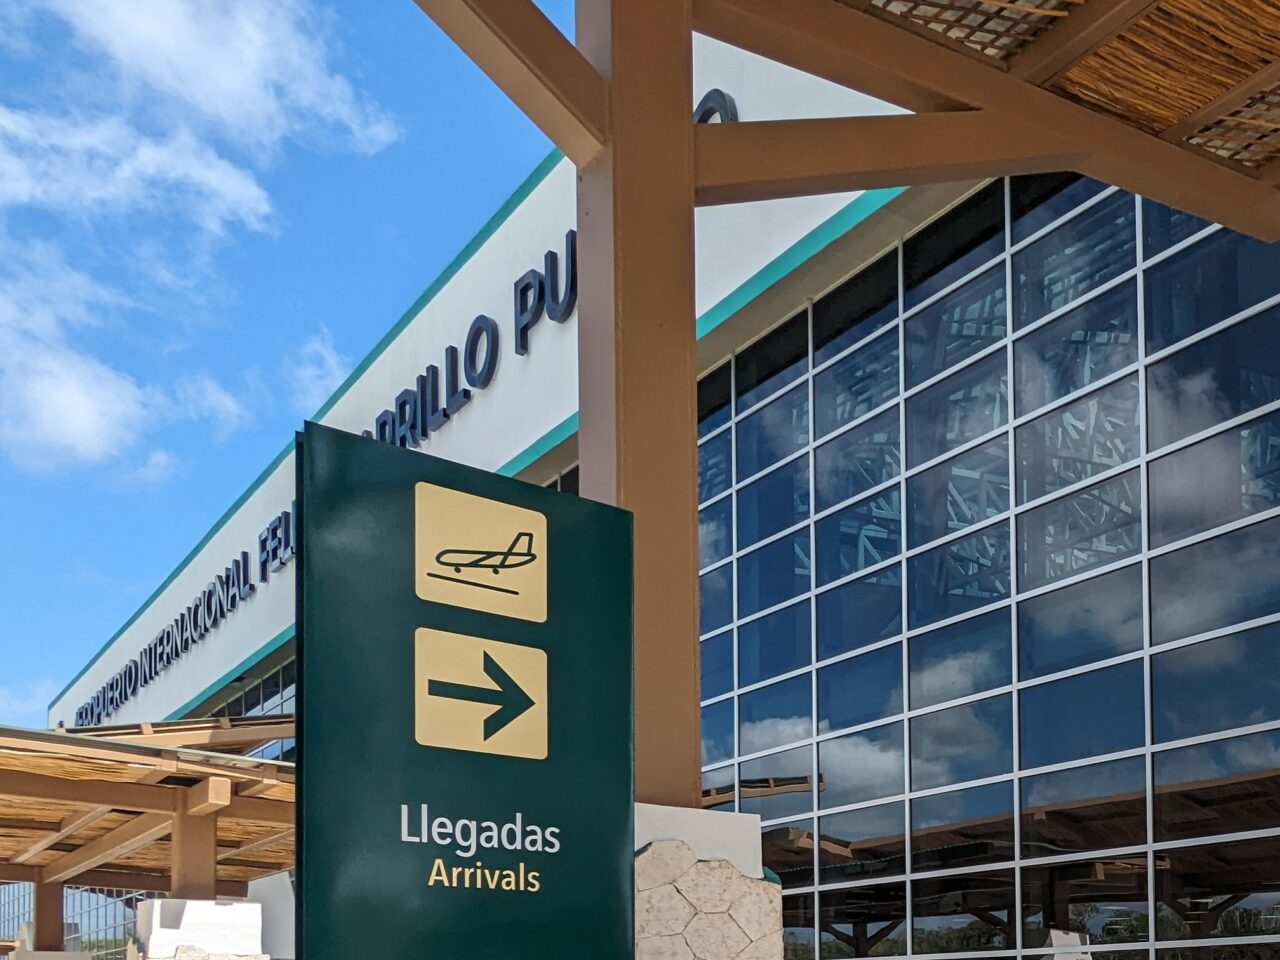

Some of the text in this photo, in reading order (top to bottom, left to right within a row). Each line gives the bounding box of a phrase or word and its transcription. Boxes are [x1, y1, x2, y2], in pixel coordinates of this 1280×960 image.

[140, 551, 255, 687] INTERNACIONAL
[401, 803, 561, 858] Llegadas
[428, 858, 541, 892] Arrivals
